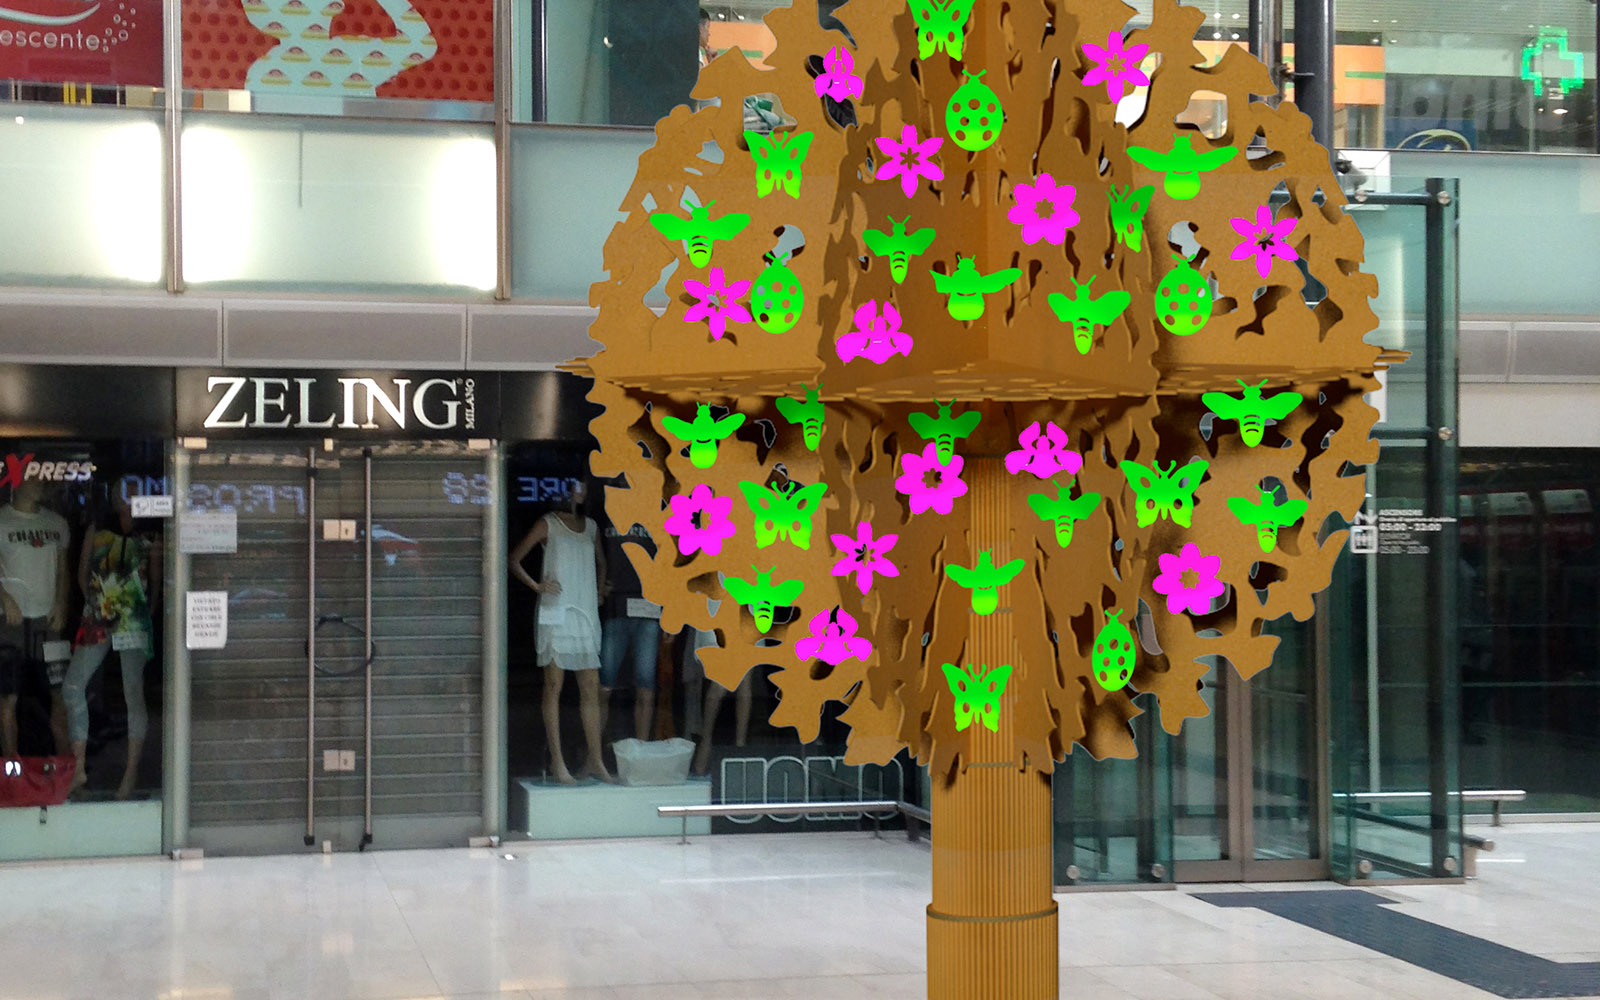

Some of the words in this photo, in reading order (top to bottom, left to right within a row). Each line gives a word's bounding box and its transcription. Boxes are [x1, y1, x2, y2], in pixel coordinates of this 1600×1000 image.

[203, 376, 462, 429] ZELING
[465, 378, 475, 430] MILANO
[0, 453, 92, 489] XPRESS
